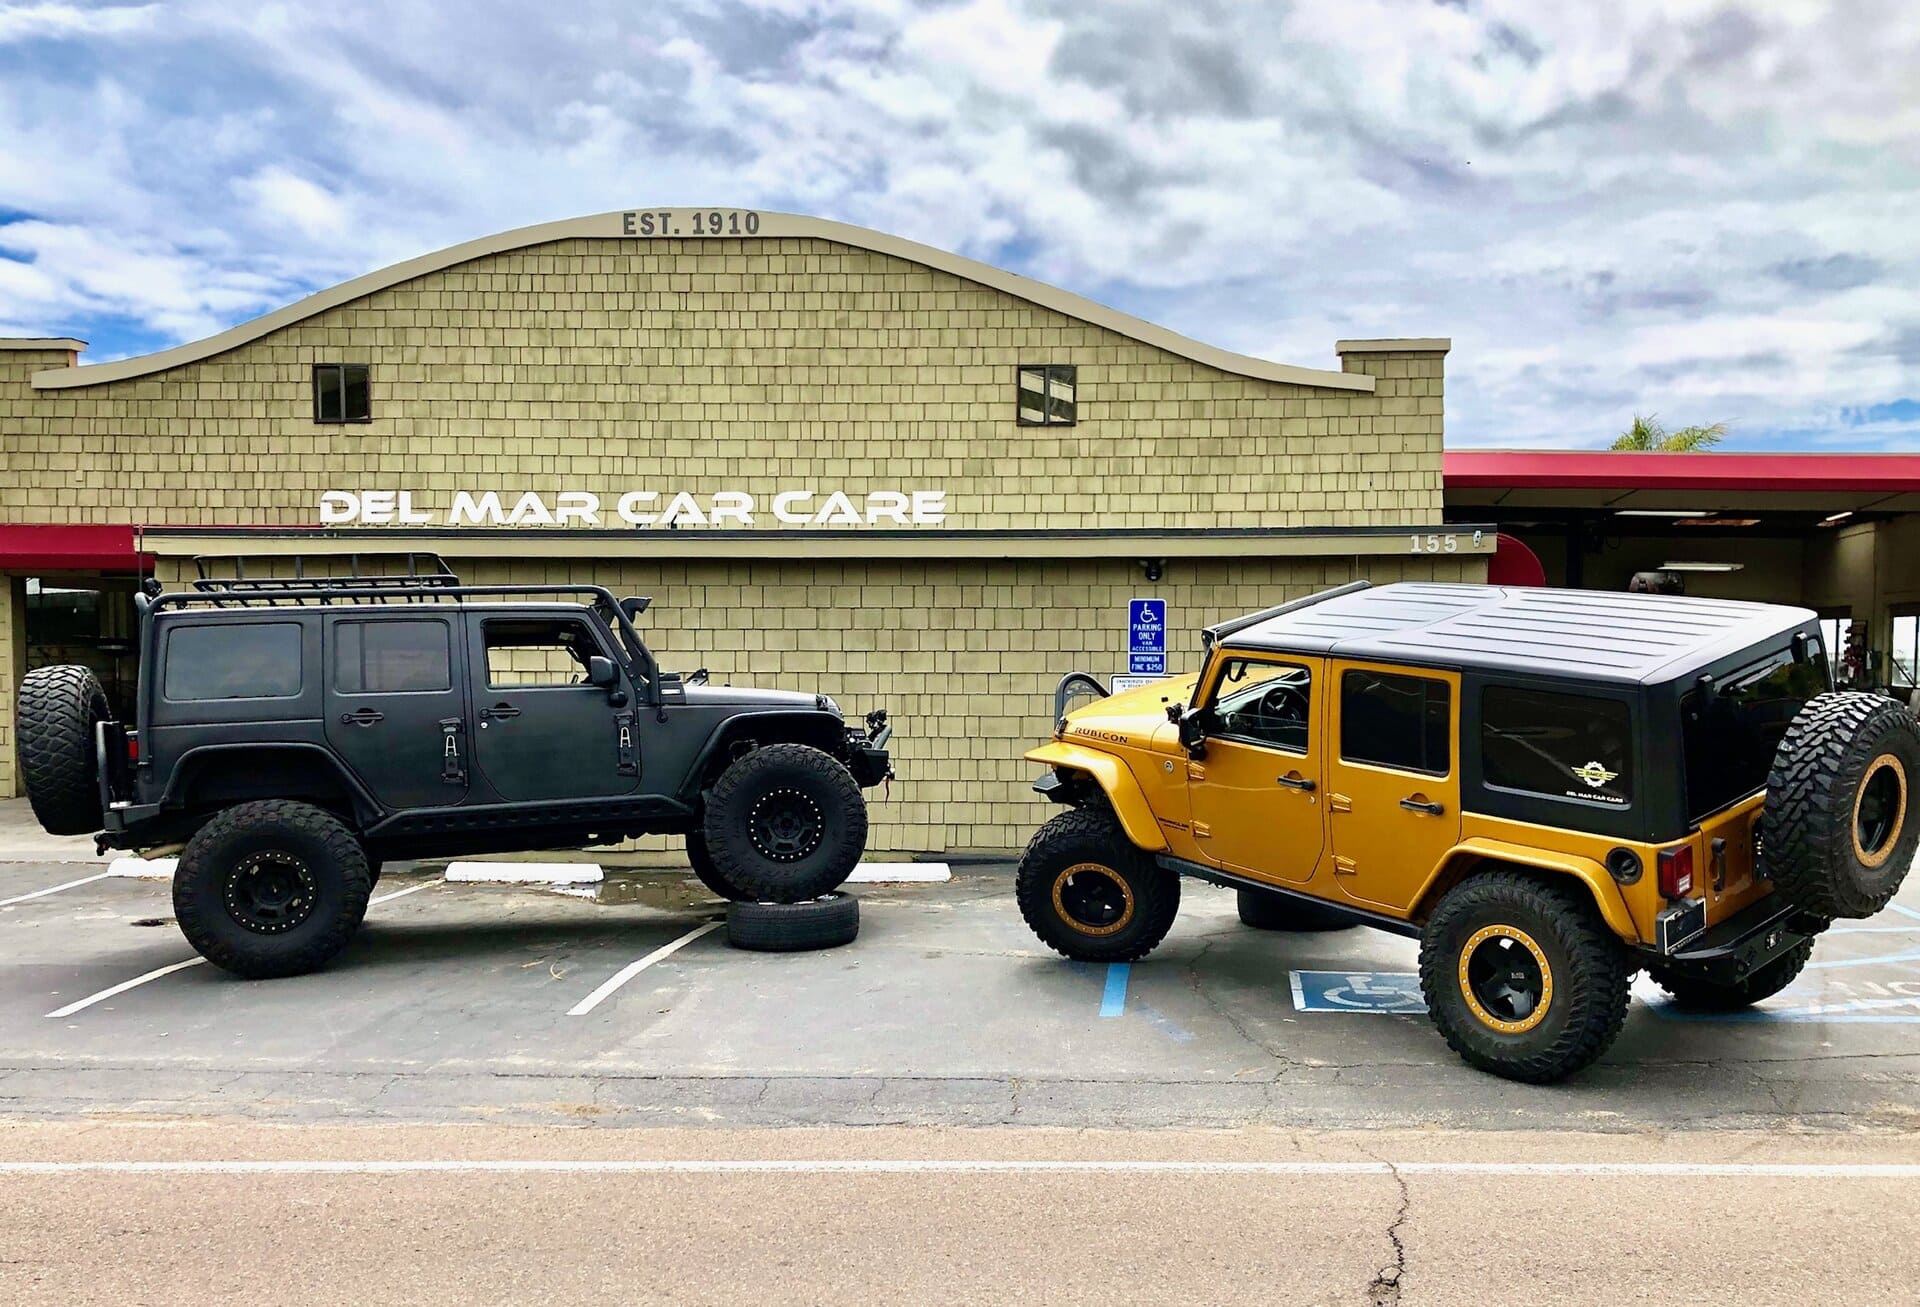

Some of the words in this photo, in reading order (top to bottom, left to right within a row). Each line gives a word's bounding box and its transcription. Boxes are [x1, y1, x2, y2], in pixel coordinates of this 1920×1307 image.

[623, 213, 680, 235] EST.
[693, 212, 760, 235] 1910
[319, 490, 433, 523] DEL
[448, 491, 600, 523] MAR
[617, 491, 756, 523] CAR
[772, 491, 947, 523] CARE
[1410, 535, 1457, 553] 155
[1138, 632, 1156, 640] ONLY
[1075, 727, 1128, 743] RUBICON
